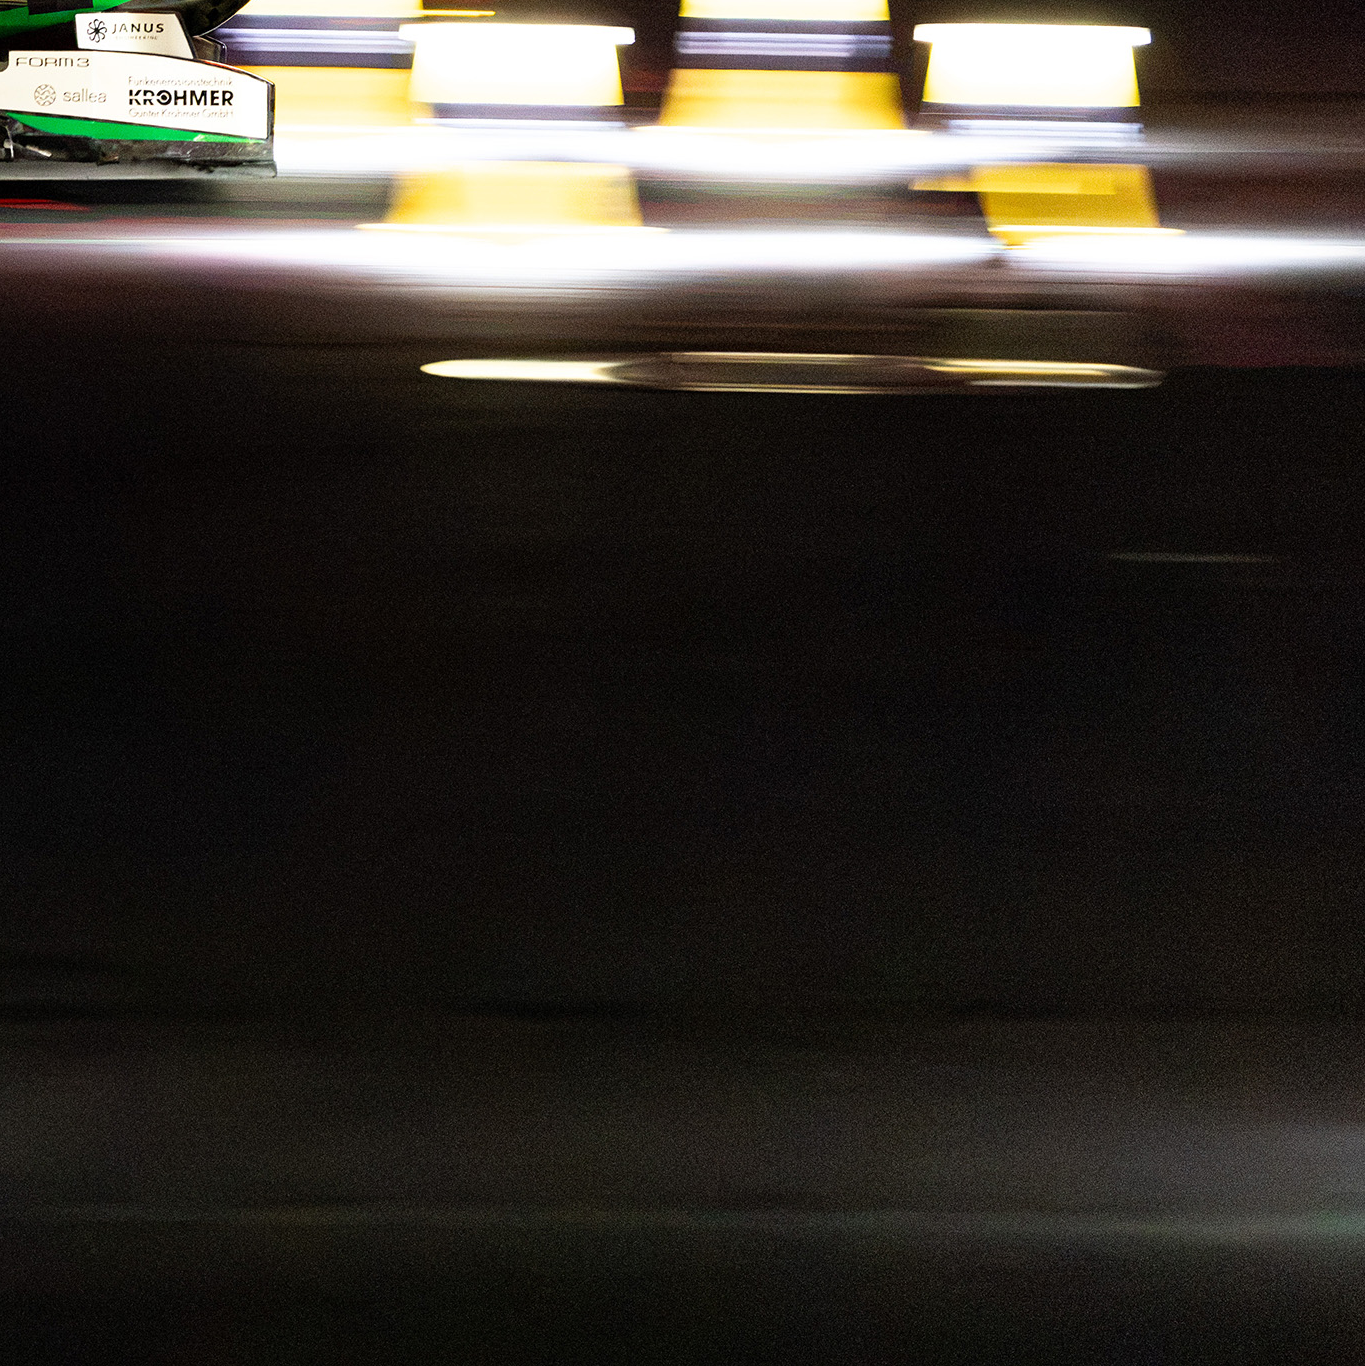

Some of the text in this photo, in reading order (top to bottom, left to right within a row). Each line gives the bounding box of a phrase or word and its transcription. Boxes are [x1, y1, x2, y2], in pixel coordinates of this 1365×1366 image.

[111, 23, 164, 34] JANUS
[15, 56, 90, 68] FORM 3
[62, 88, 107, 104] sallea
[129, 89, 234, 106] KROHMER
